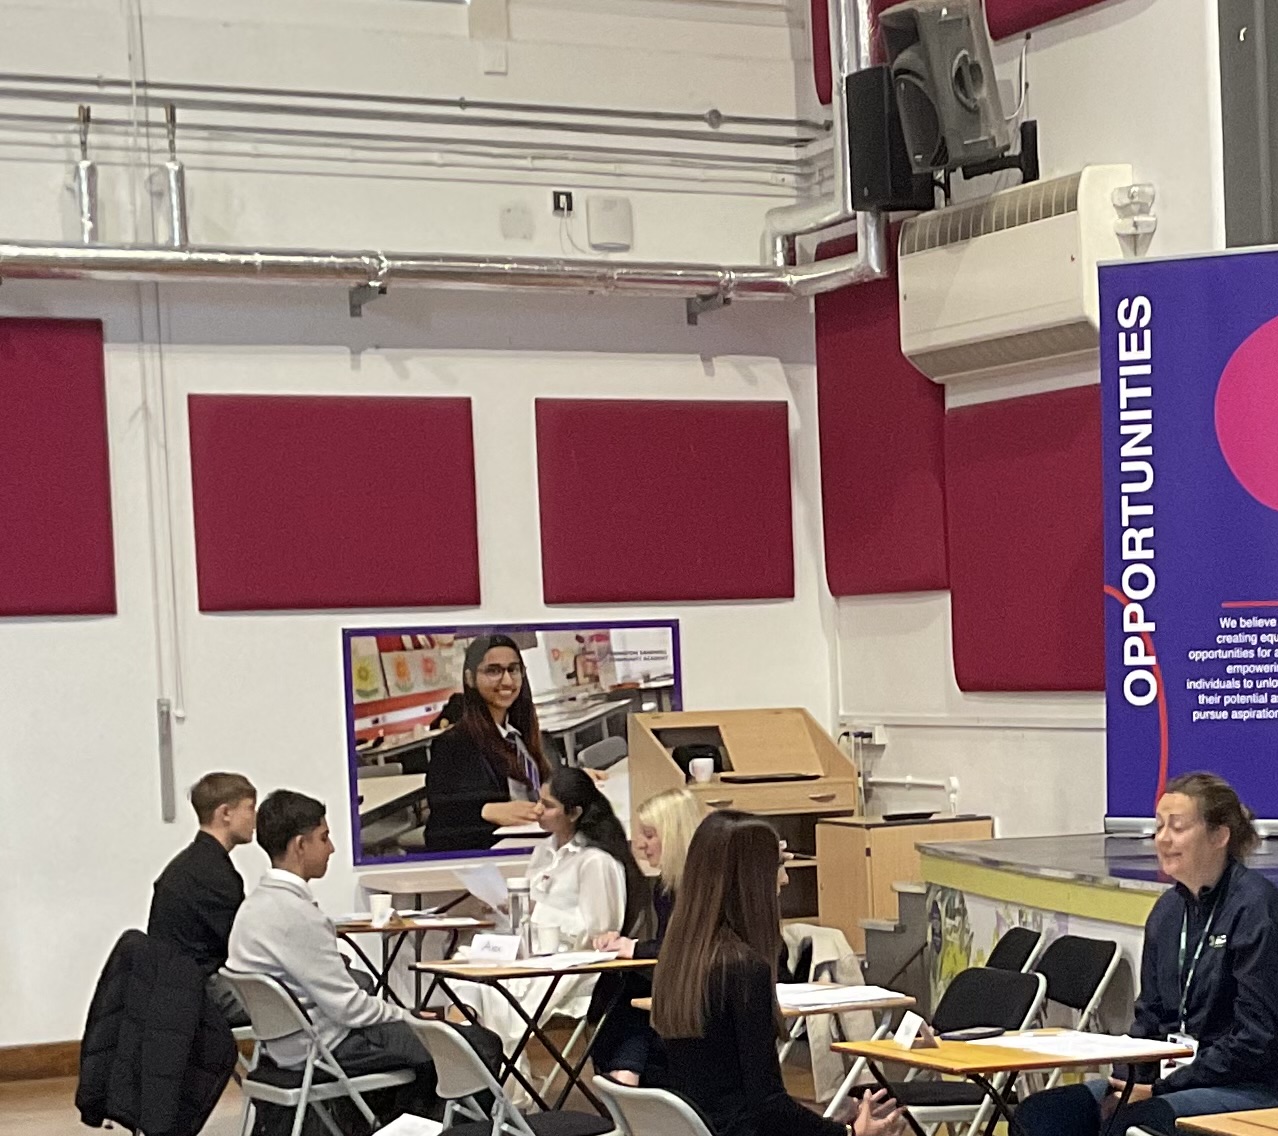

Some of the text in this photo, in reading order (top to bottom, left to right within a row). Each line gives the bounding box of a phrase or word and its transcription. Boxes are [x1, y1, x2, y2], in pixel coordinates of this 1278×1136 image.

[1116, 294, 1158, 706] OPPORTUNITIES
[1219, 617, 1237, 628] We
[1239, 616, 1277, 628] believe
[1216, 632, 1258, 645] creating
[1188, 648, 1255, 662] opportunities
[1257, 647, 1272, 658] for
[1186, 678, 1241, 690] individuals
[1243, 678, 1254, 689] to
[1198, 693, 1221, 705] their
[1223, 693, 1268, 707] potential
[1192, 709, 1229, 723] pursue
